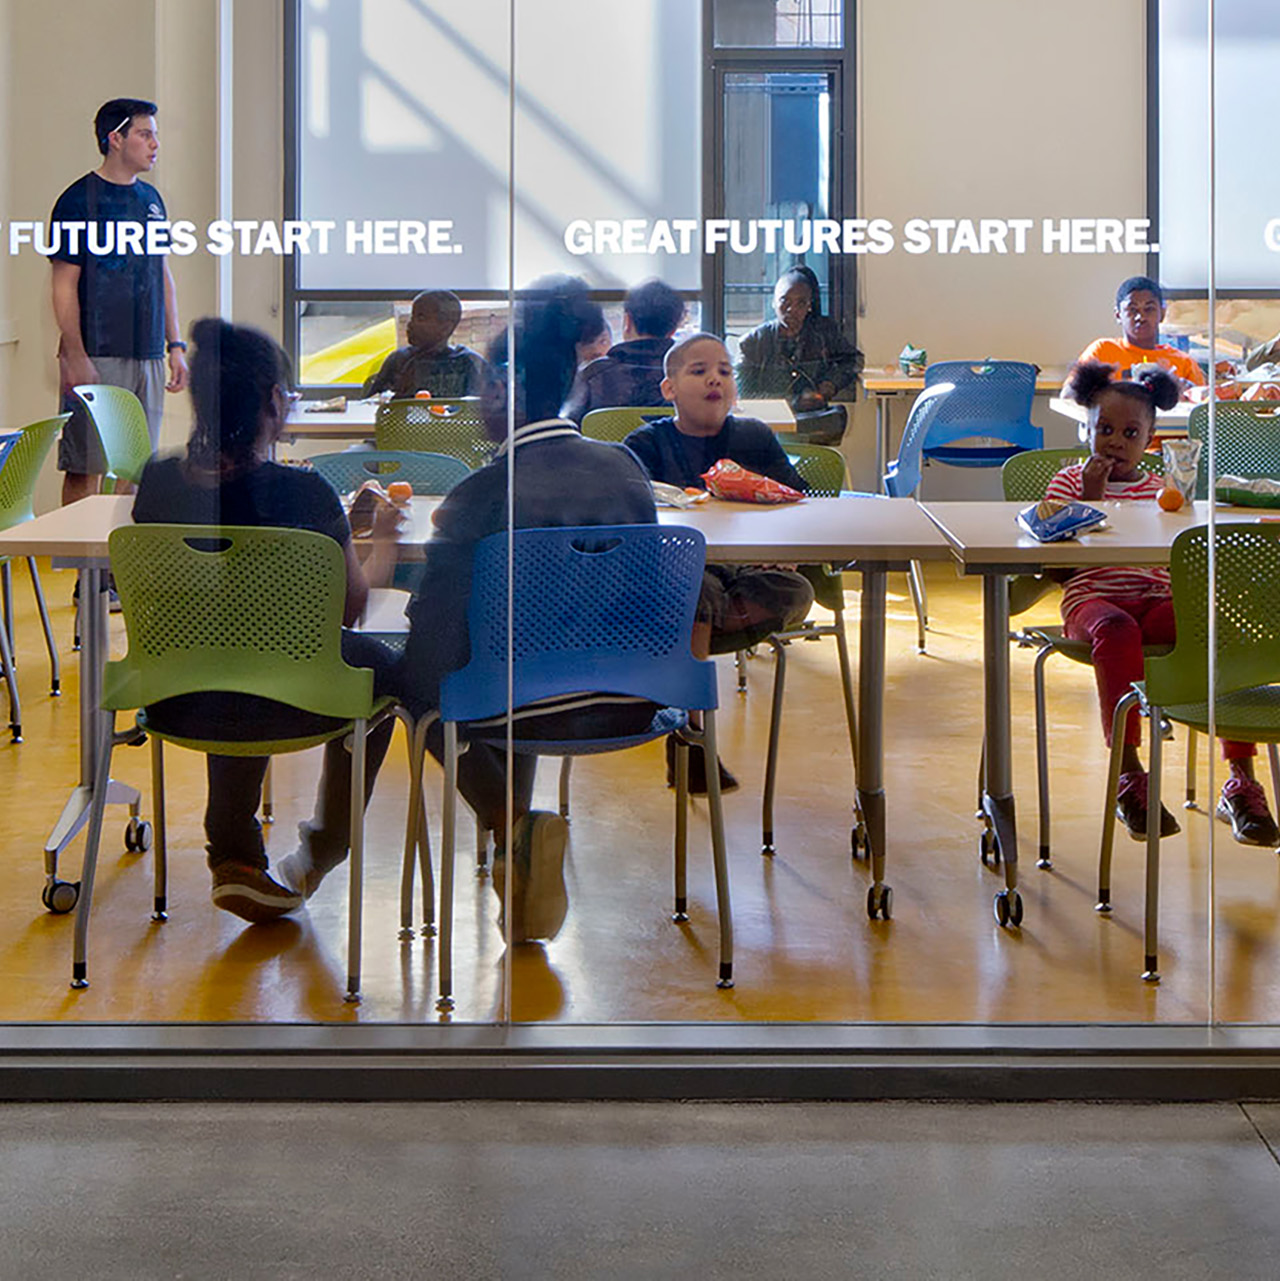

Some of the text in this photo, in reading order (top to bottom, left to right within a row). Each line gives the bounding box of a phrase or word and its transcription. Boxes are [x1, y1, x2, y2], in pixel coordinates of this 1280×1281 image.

[9, 220, 198, 256] FUTURES
[206, 220, 336, 255] START
[345, 220, 463, 255] HERE.
[564, 219, 1160, 255] GREAT FUTURES START HERE.
